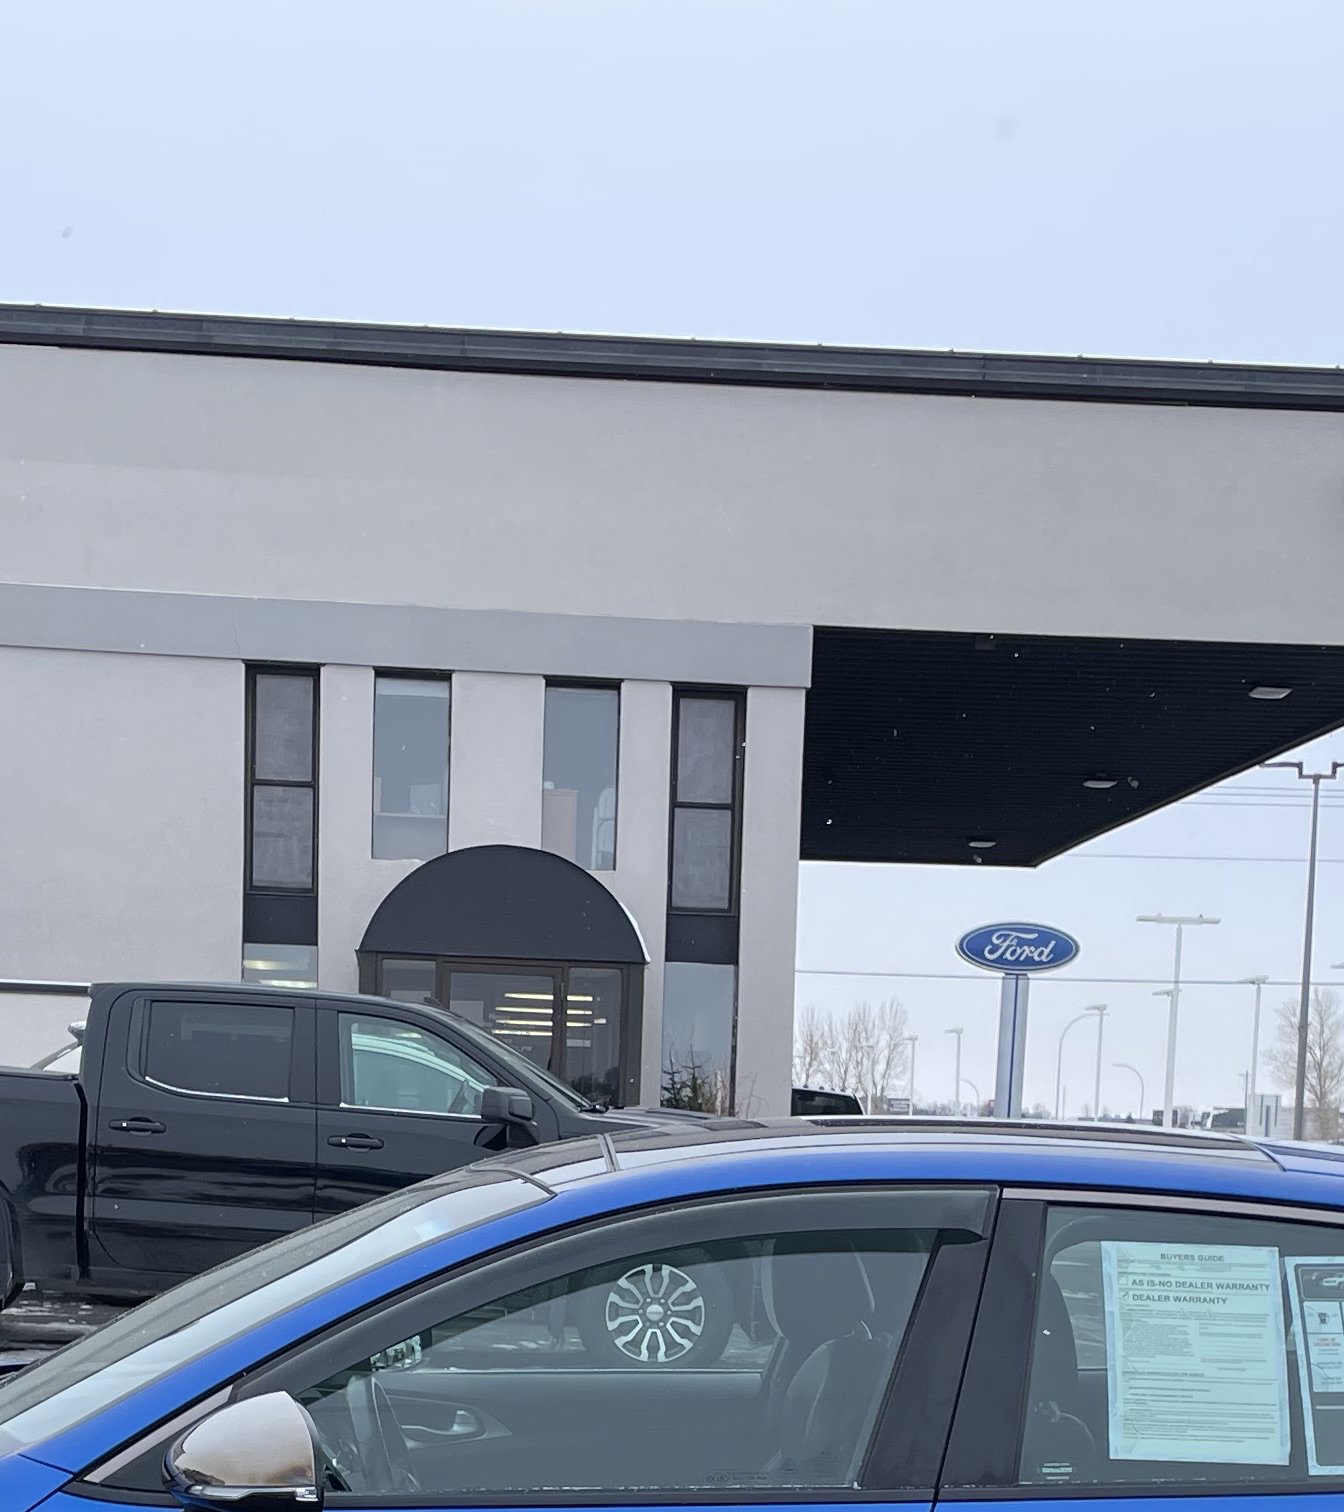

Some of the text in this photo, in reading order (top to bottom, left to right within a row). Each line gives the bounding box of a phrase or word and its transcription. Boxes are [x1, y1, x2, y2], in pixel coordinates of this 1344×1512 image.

[983, 930, 1056, 962] Ford
[1197, 1254, 1225, 1263] GUIDE
[1131, 1279, 1145, 1288] AS
[1175, 1281, 1214, 1290] DEALER
[1215, 1282, 1271, 1292] WARRANTY
[1132, 1293, 1228, 1305] DEALER WARRANTY
